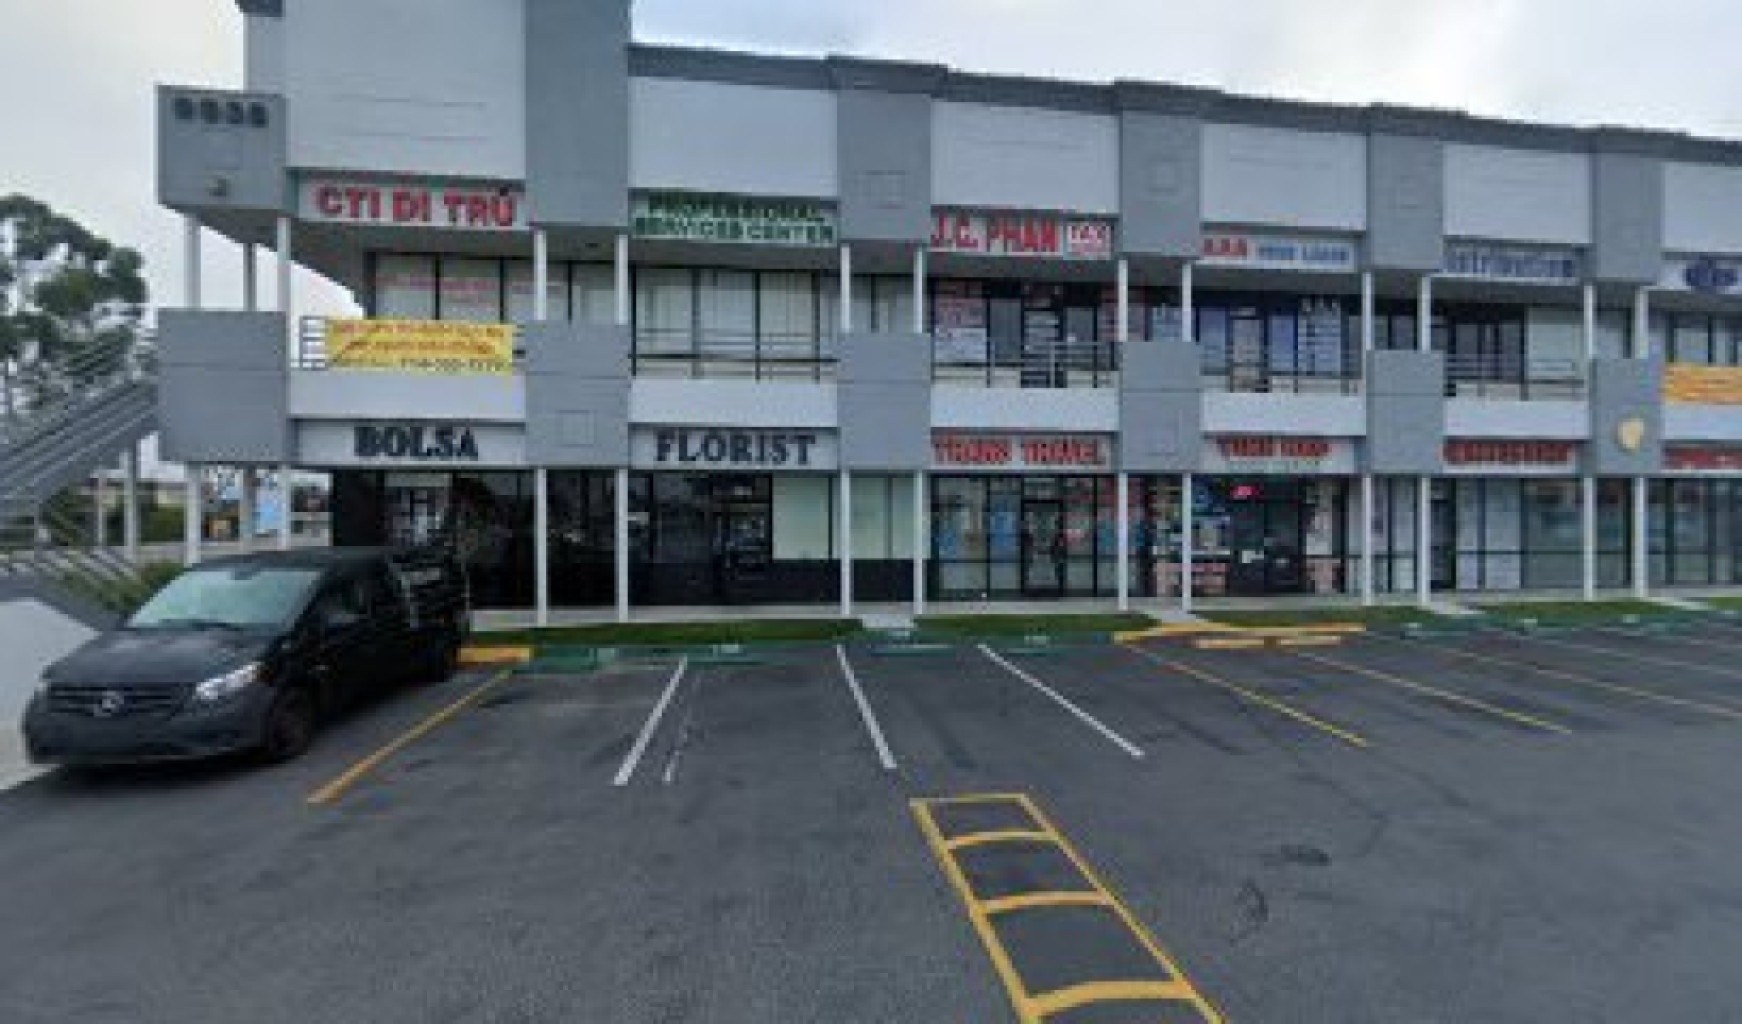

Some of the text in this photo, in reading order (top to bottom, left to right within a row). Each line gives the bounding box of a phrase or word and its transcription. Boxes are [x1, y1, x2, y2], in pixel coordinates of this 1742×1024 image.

[316, 186, 380, 219] CTI
[636, 217, 834, 245] SERVICES CENTER
[354, 426, 479, 461] BOLSA
[655, 430, 816, 465] FLORIST
